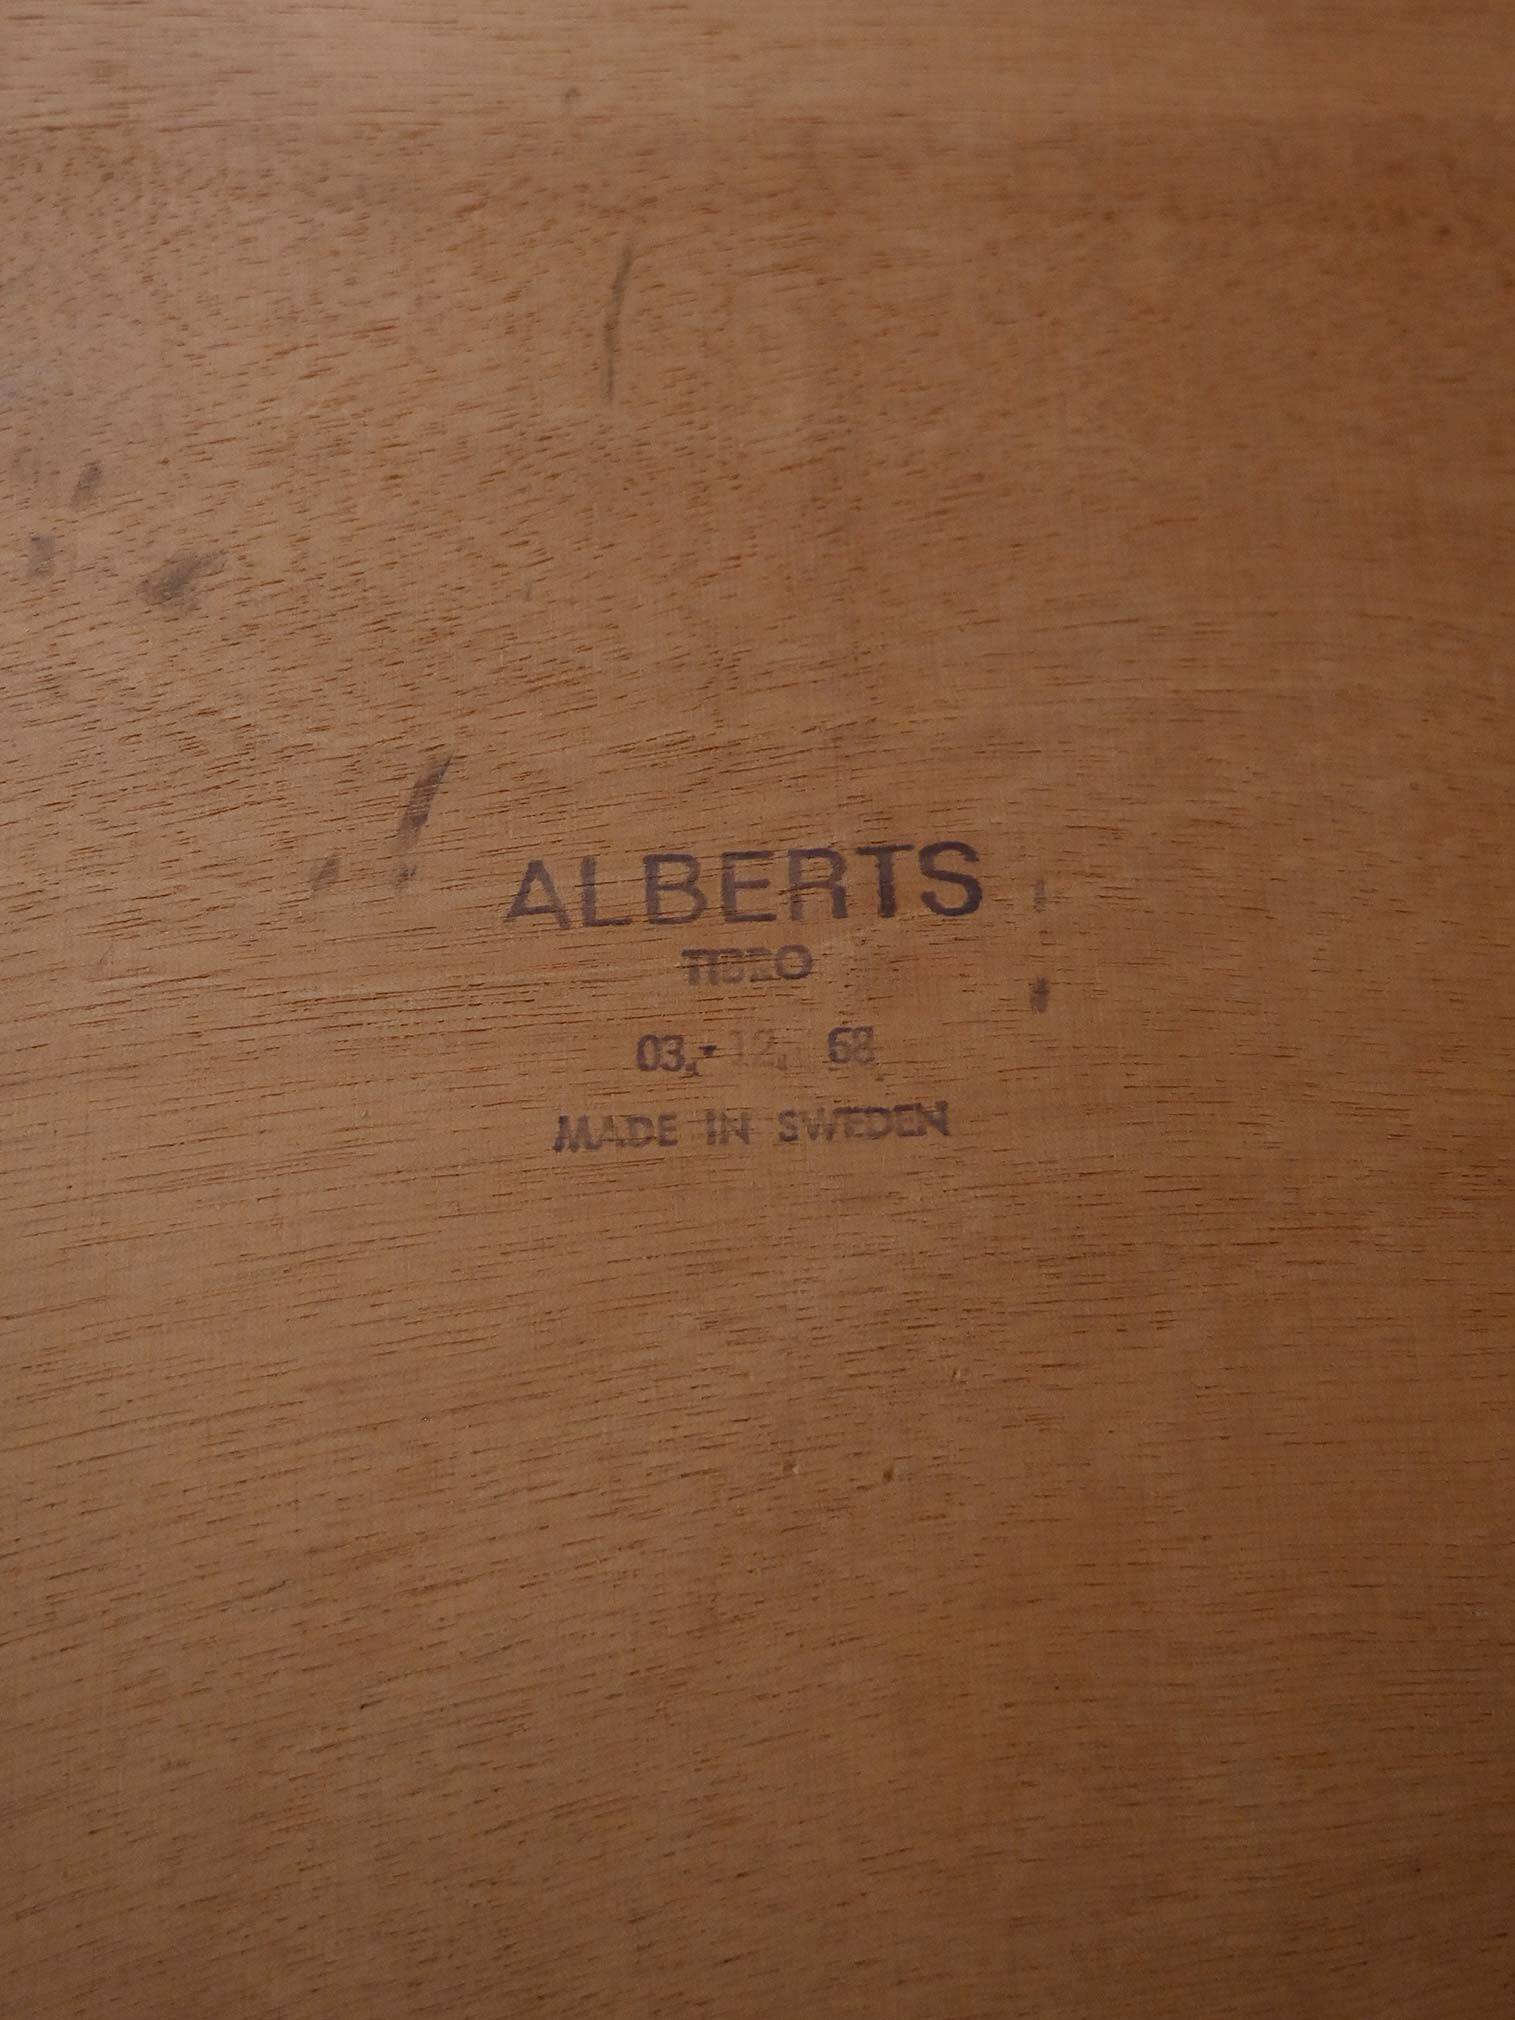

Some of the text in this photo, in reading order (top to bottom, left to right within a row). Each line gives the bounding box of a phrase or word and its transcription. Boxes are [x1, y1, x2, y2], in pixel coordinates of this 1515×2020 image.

[504, 839, 985, 929] ALBERTS
[552, 1101, 949, 1153] MADE IN SWEDEN
